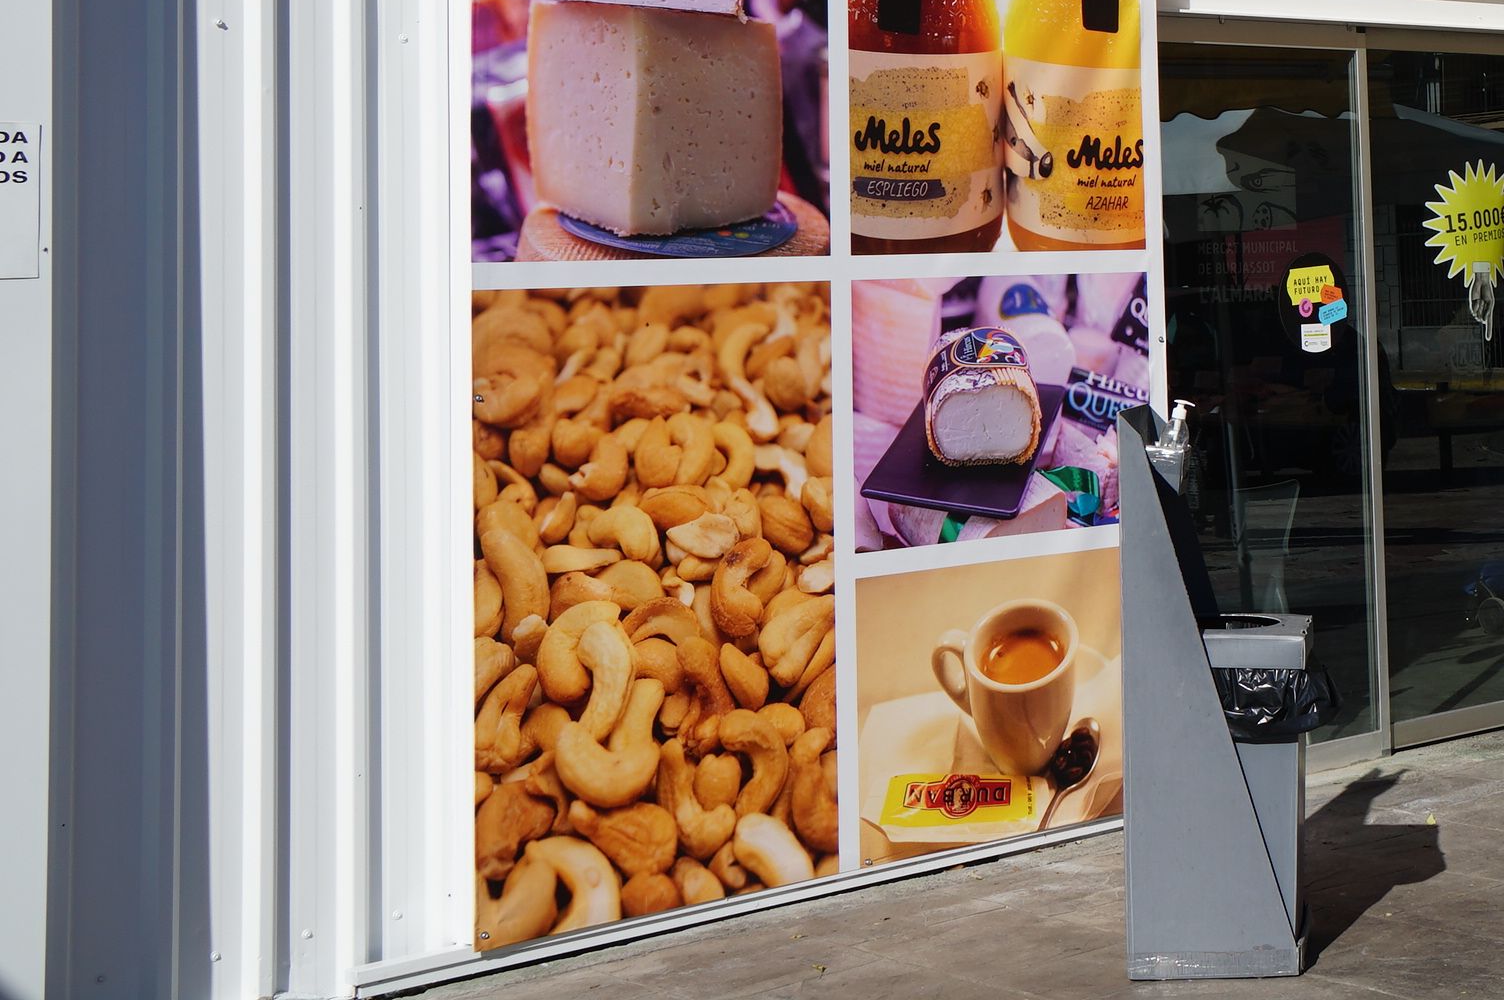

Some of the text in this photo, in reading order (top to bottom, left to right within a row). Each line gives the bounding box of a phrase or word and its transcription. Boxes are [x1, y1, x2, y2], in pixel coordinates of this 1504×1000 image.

[854, 115, 941, 155] Meles
[1066, 134, 1144, 171] Meles
[863, 159, 931, 174] miel natural
[866, 180, 928, 197] ESPLIEGO
[1076, 174, 1136, 188] miel natural
[1085, 195, 1129, 210] AZAHAR
[1242, 240, 1299, 254] MUNICIPAL
[1454, 234, 1468, 246] EN
[1293, 275, 1327, 286] AQUÍ HAY
[1294, 285, 1320, 295] FUTURO
[907, 785, 1007, 803] DURBAN
